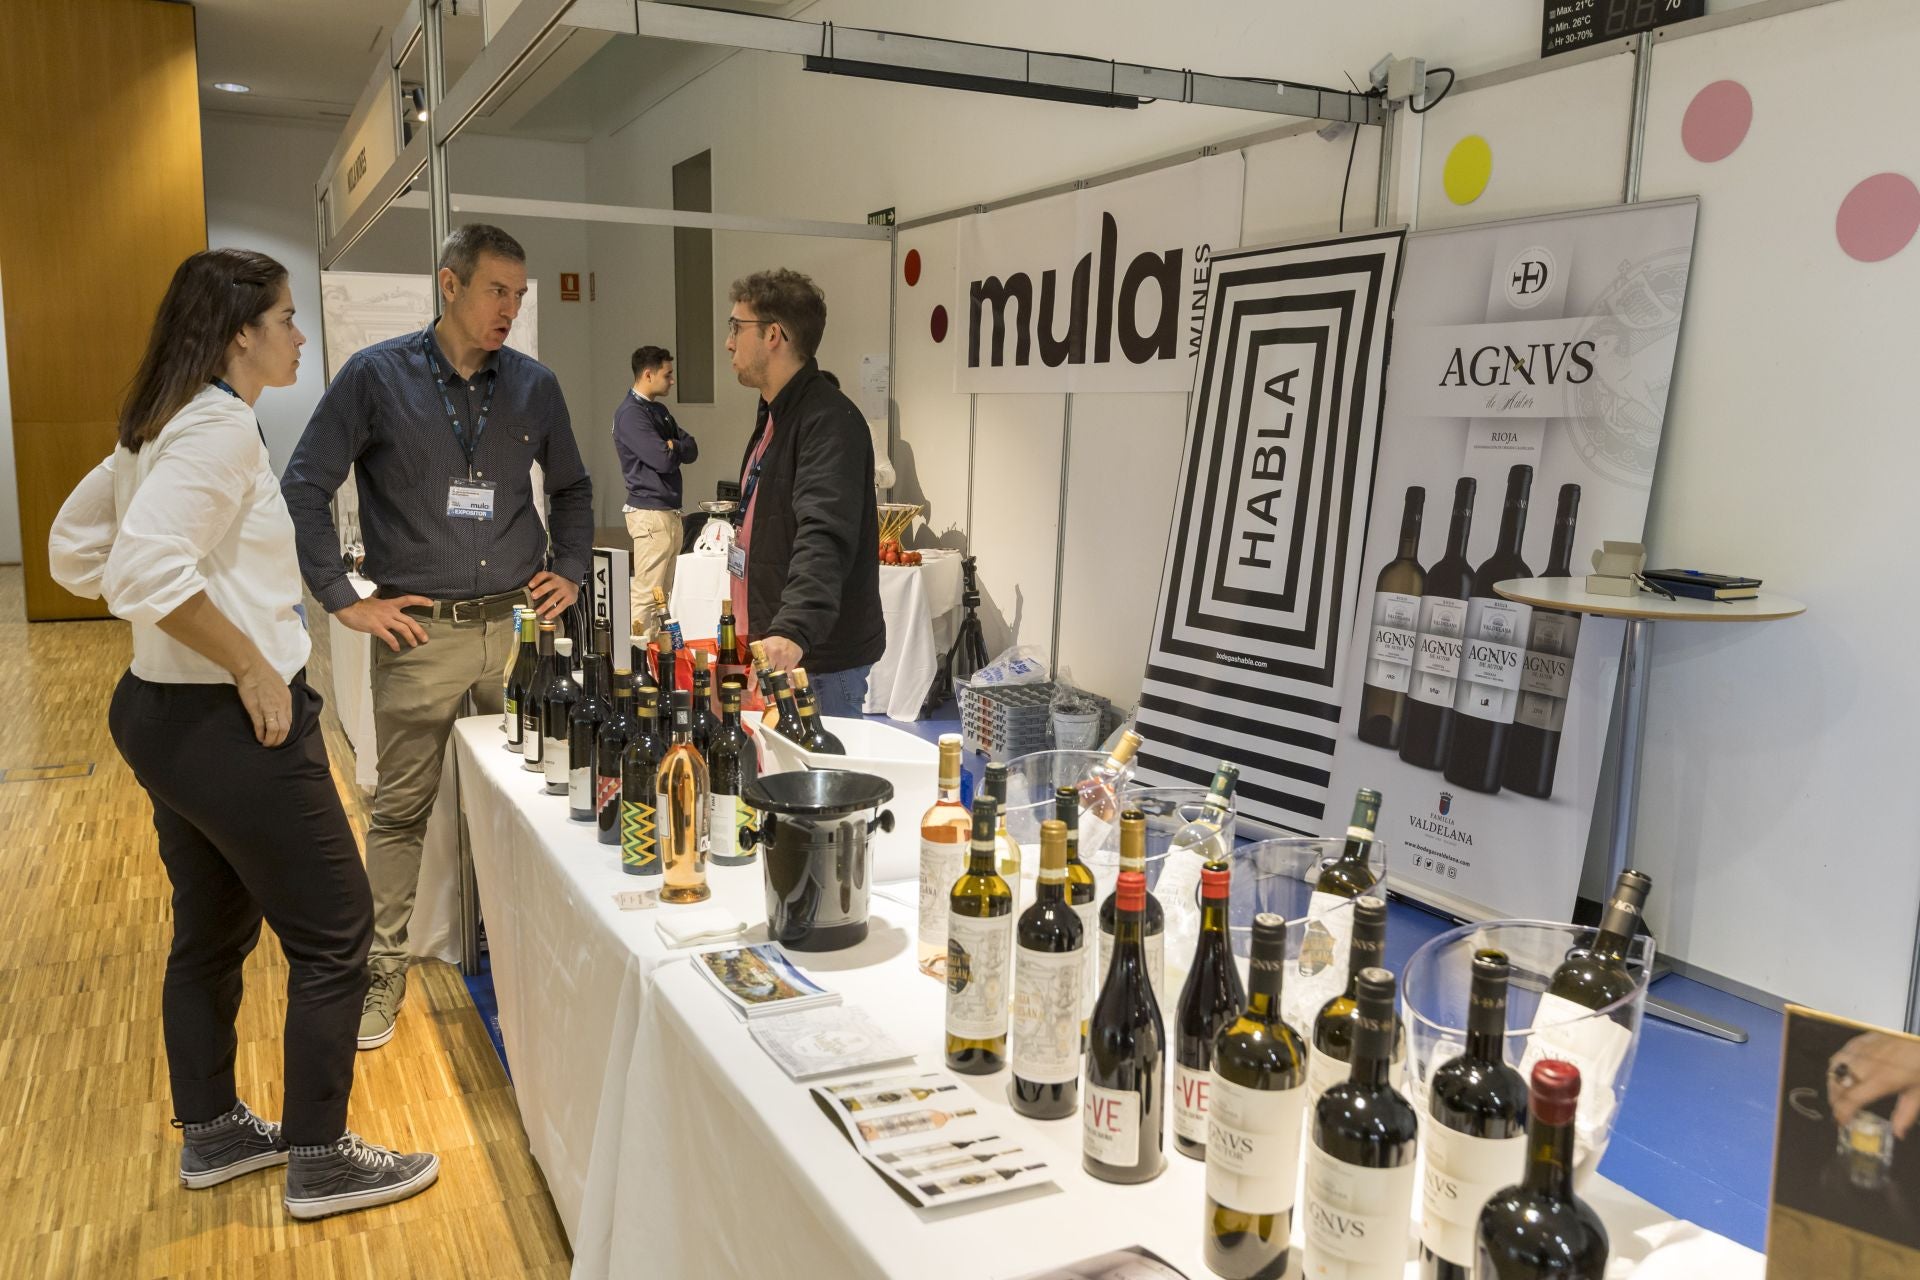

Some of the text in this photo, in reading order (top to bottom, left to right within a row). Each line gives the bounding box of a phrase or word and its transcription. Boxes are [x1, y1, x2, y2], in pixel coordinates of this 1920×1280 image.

[1556, 6, 1574, 16] Max.
[1555, 21, 1571, 33] Min.
[1554, 29, 1593, 47] Hr 30-70%
[969, 211, 1183, 367] mula
[1189, 243, 1211, 358] WINES
[1438, 340, 1596, 387] AGNVS
[1491, 432, 1518, 444] RIOJA
[1238, 368, 1299, 569] HABLA
[1376, 630, 1415, 648] AGNVS
[1420, 639, 1463, 658] AGNVS
[1216, 651, 1268, 669] bodegashabla.com
[1468, 644, 1518, 667] AGNVS
[1523, 656, 1565, 677] AGNVS
[1430, 812, 1455, 825] FAMILIA
[1409, 815, 1473, 846] VALDELANA
[1404, 841, 1471, 867] www.bodegasvaldelana.com
